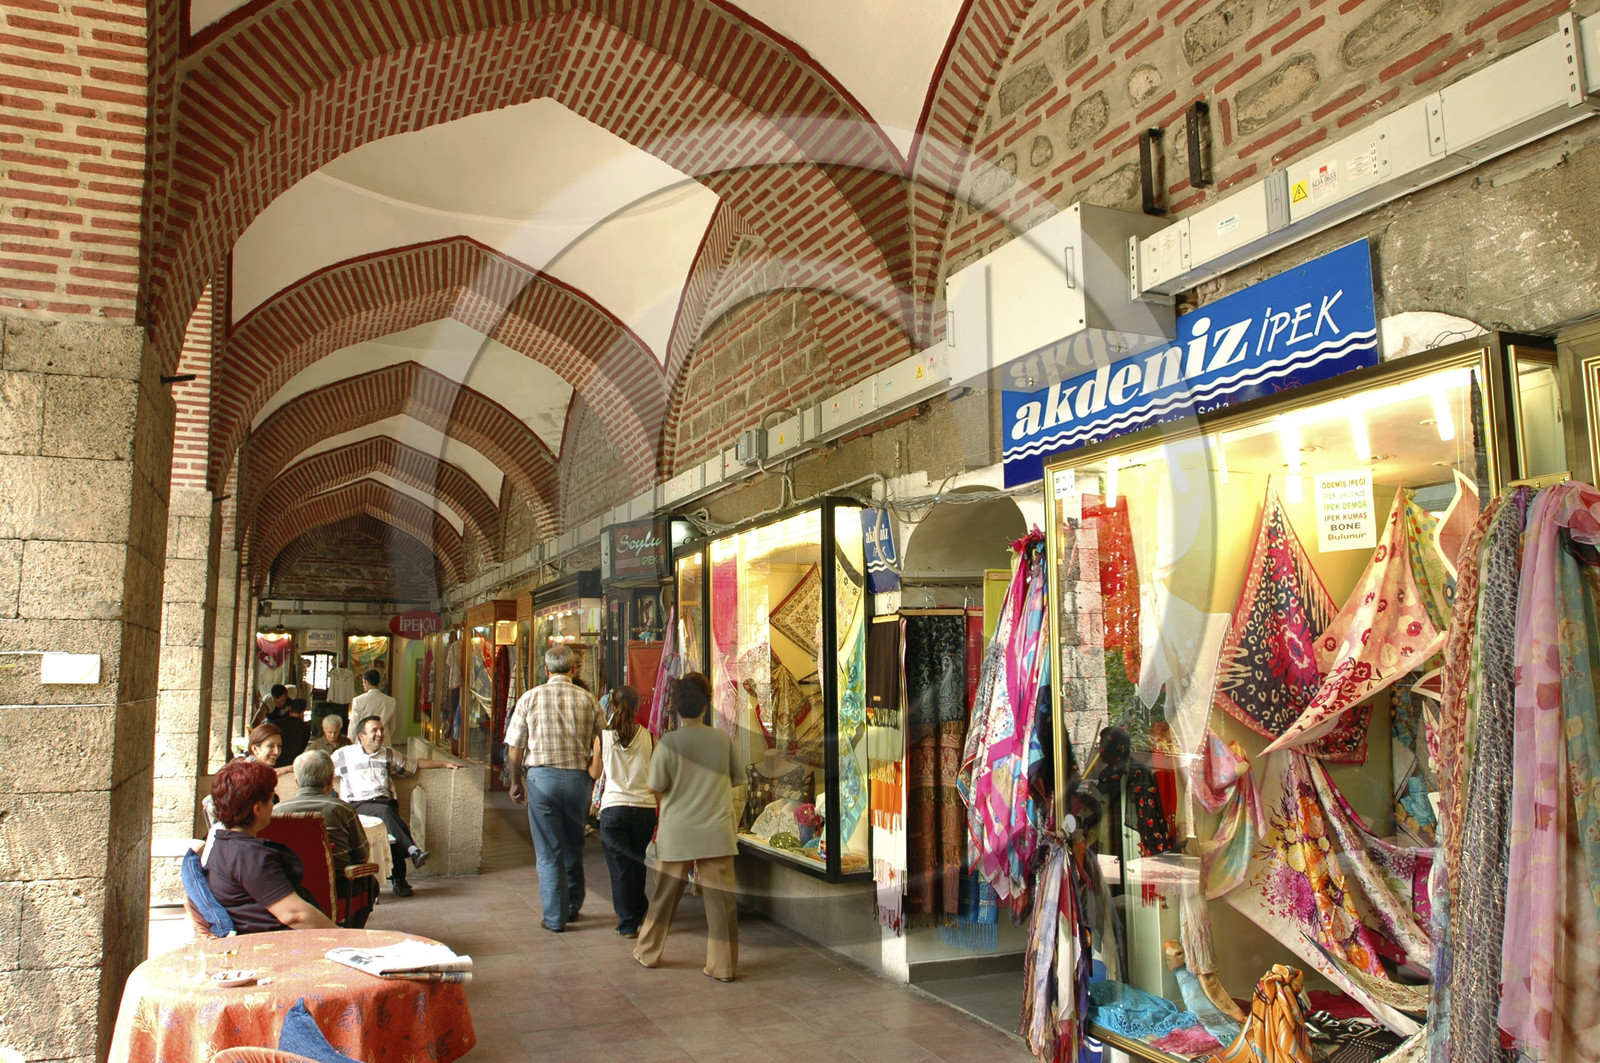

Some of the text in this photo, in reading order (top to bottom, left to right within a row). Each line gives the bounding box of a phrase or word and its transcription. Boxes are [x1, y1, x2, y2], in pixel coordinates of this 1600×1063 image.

[1011, 289, 1343, 440] akdeniz İPEK
[1342, 511, 1368, 520] KUMAŞ
[1330, 521, 1361, 531] BONE
[1327, 533, 1367, 541] Bulunur
